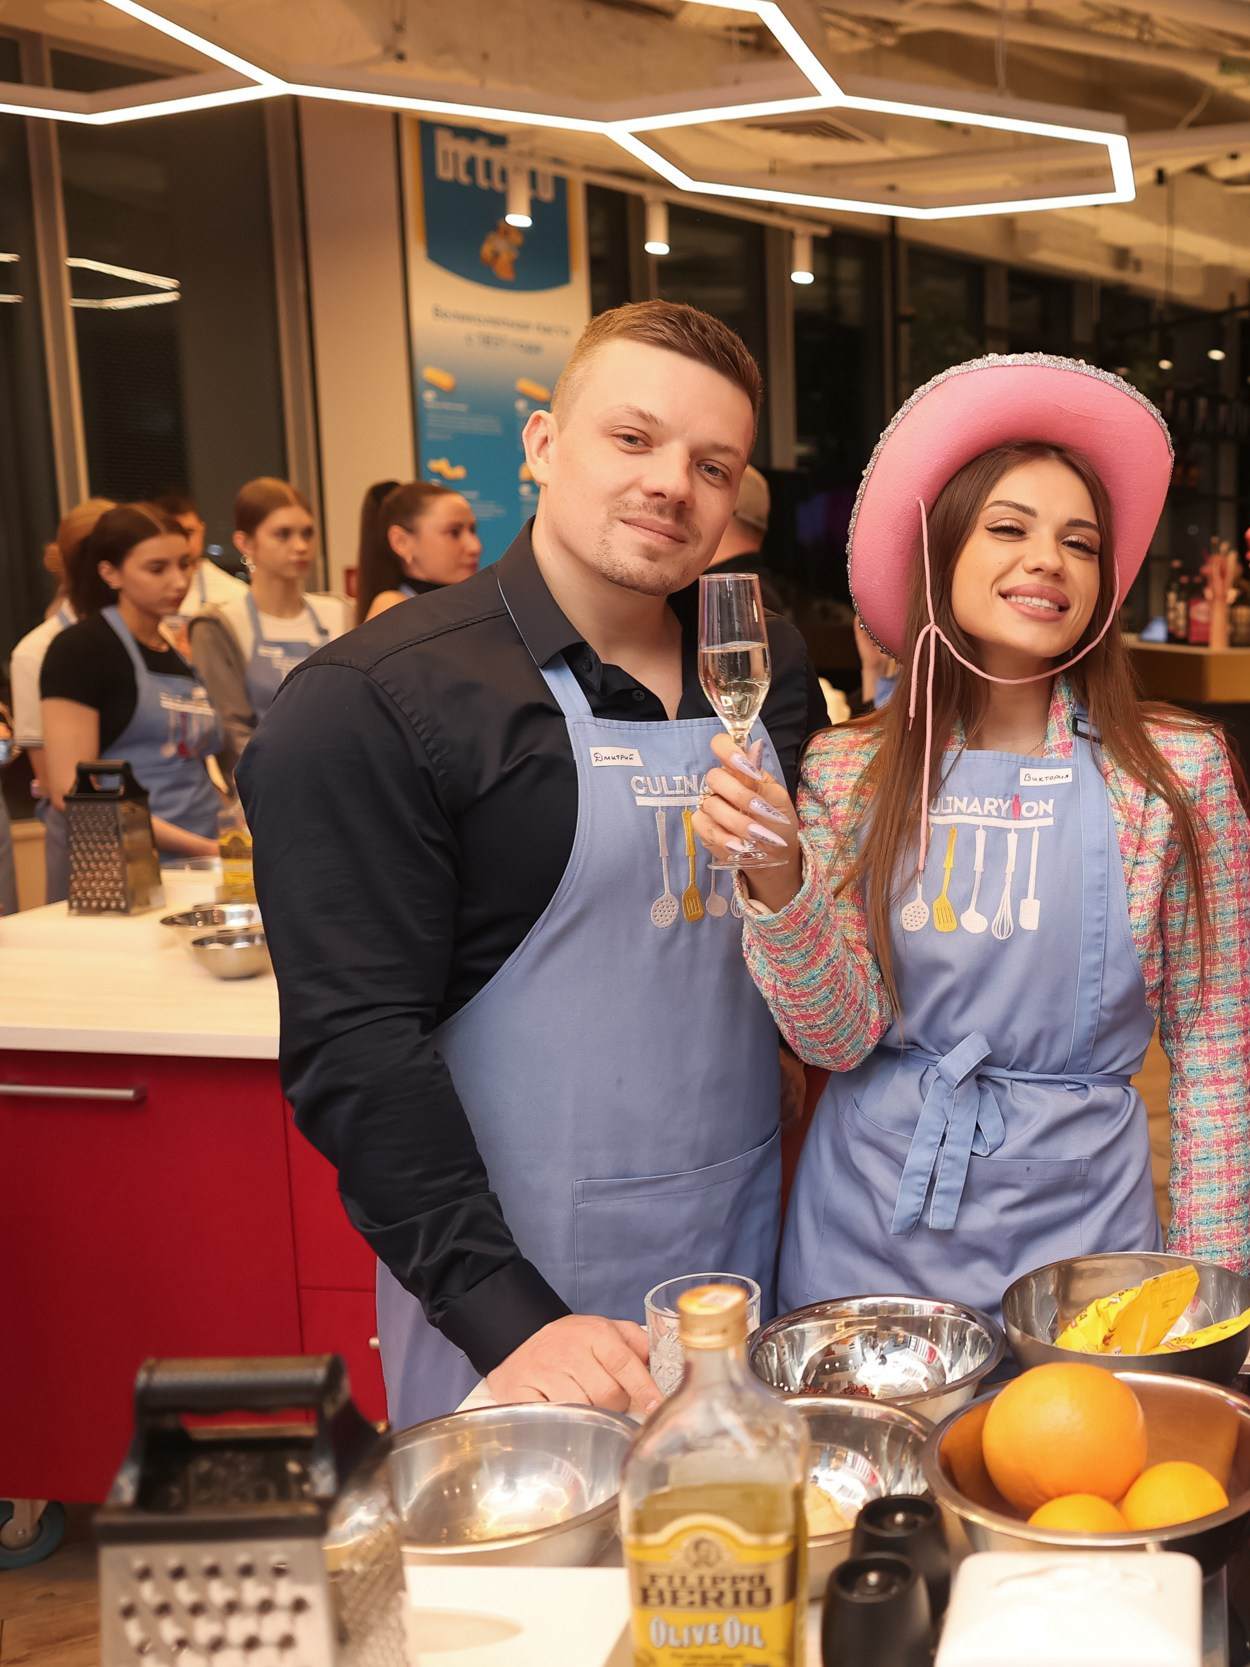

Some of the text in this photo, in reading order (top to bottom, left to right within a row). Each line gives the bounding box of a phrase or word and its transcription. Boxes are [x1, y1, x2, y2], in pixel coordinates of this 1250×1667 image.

[593, 752, 635, 762] Дмитрий
[1023, 773, 1070, 782] Виктория
[928, 796, 1012, 818] ULINARY
[649, 1573, 766, 1587] FILIPPO
[640, 1586, 773, 1608] BERIO
